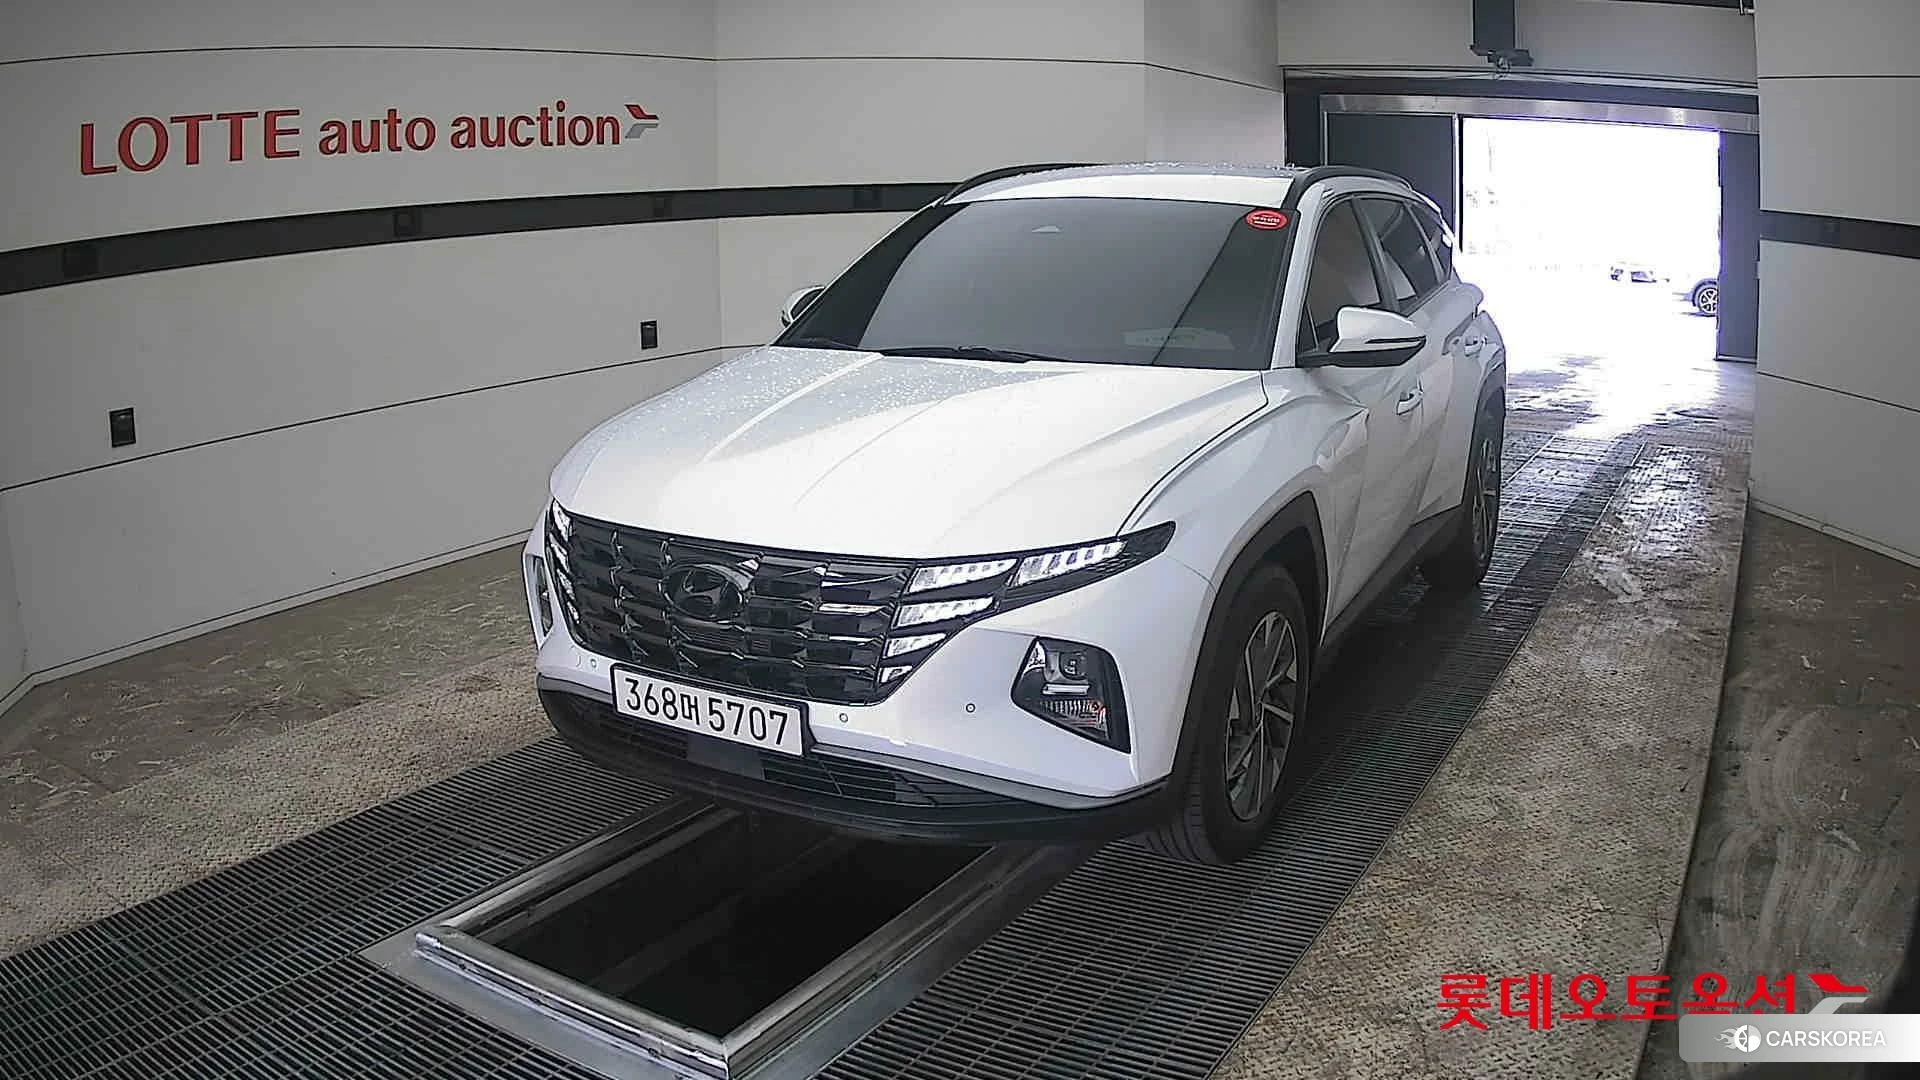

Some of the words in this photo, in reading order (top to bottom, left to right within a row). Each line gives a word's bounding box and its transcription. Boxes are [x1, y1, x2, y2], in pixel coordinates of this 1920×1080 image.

[80, 108, 301, 176] LOTTE
[318, 107, 437, 156] auto
[449, 100, 622, 149] auction
[624, 677, 701, 726] 368머
[707, 696, 789, 746] 5707
